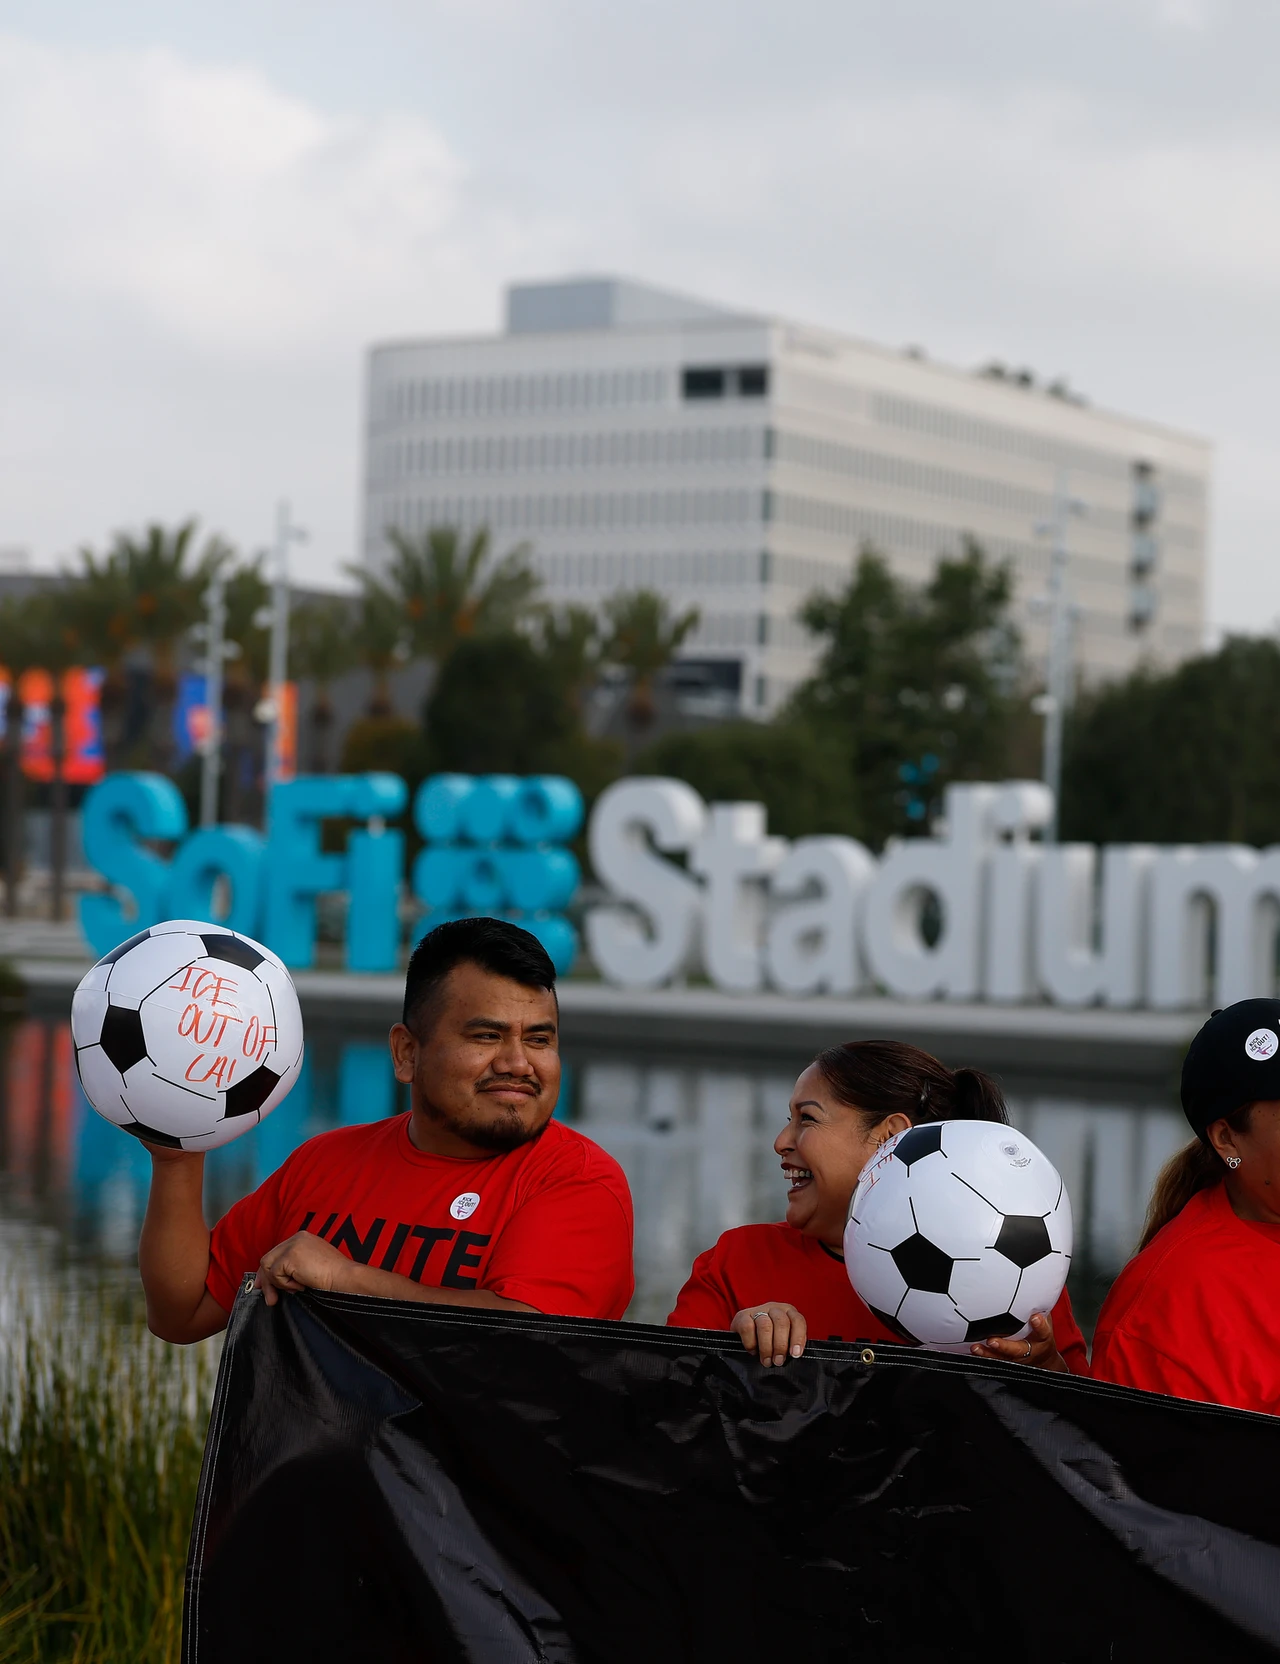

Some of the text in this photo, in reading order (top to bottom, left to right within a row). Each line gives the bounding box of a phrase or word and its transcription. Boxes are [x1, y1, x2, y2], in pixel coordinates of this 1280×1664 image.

[80, 770, 408, 974] SoFi
[169, 966, 238, 1007] ICE
[177, 1003, 277, 1061] OUT OF
